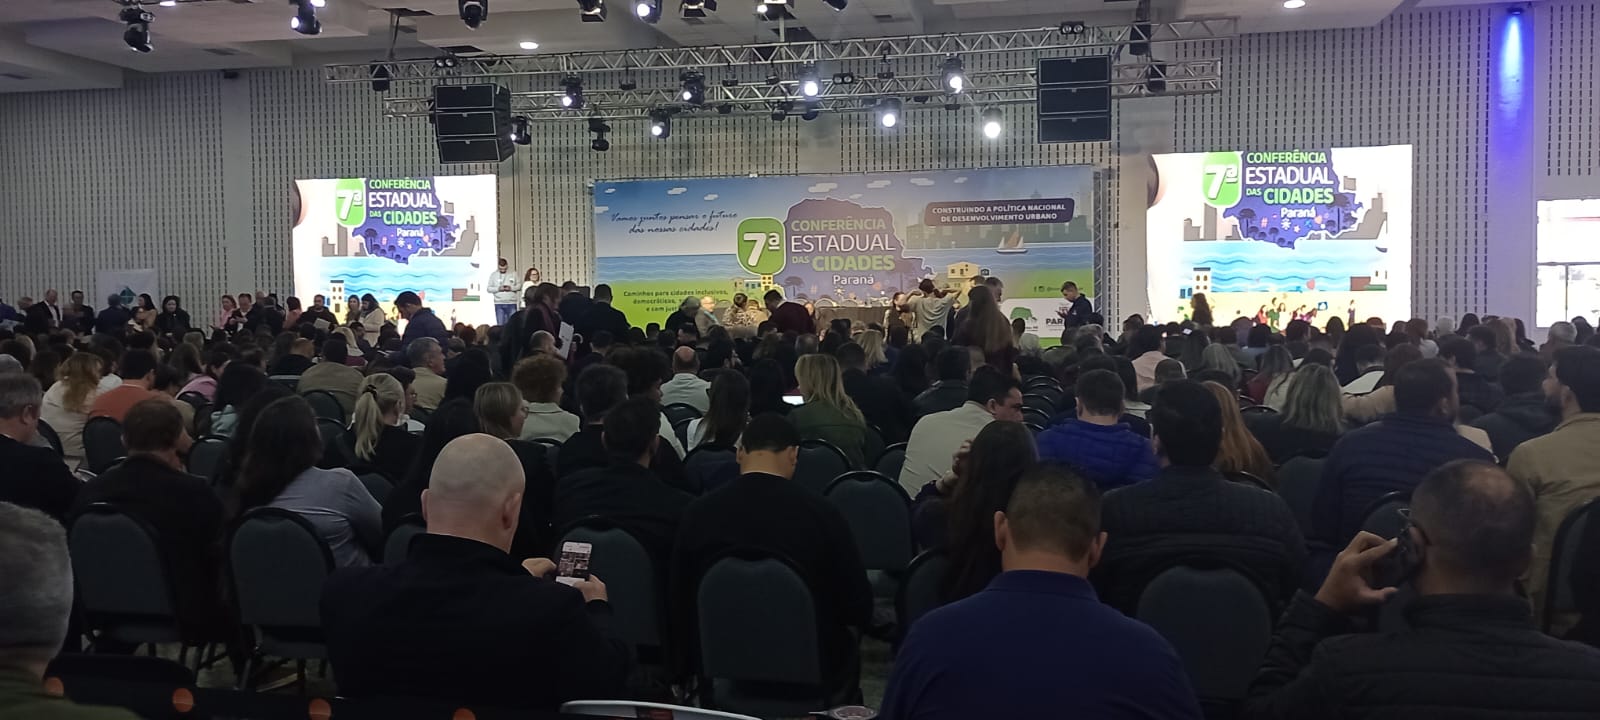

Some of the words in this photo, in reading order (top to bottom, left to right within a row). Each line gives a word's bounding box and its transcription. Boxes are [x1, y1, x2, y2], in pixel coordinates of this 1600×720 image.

[1246, 149, 1327, 164] CONFERÊNCIA
[1245, 166, 1335, 185] ESTADUAL
[369, 177, 431, 190] CONFERÊNCIA
[368, 191, 438, 208] ESTADUAL
[1246, 188, 1262, 196] DAS
[1263, 187, 1335, 204] CIDADES
[932, 206, 985, 214] CONSTRUINDO
[993, 204, 1027, 212] POLÍTICA
[1280, 206, 1316, 218] Paraná
[369, 210, 382, 218] DAS
[383, 210, 438, 225] CIDADES
[791, 216, 886, 232] CONFERÊNCIA
[952, 214, 1025, 222] DESENVOLVIMENTO
[396, 227, 424, 238] Paraná
[791, 234, 897, 253] ESTADUAL
[792, 255, 810, 264] DAS
[812, 255, 896, 272] CIDADES
[833, 273, 874, 285] Paraná
